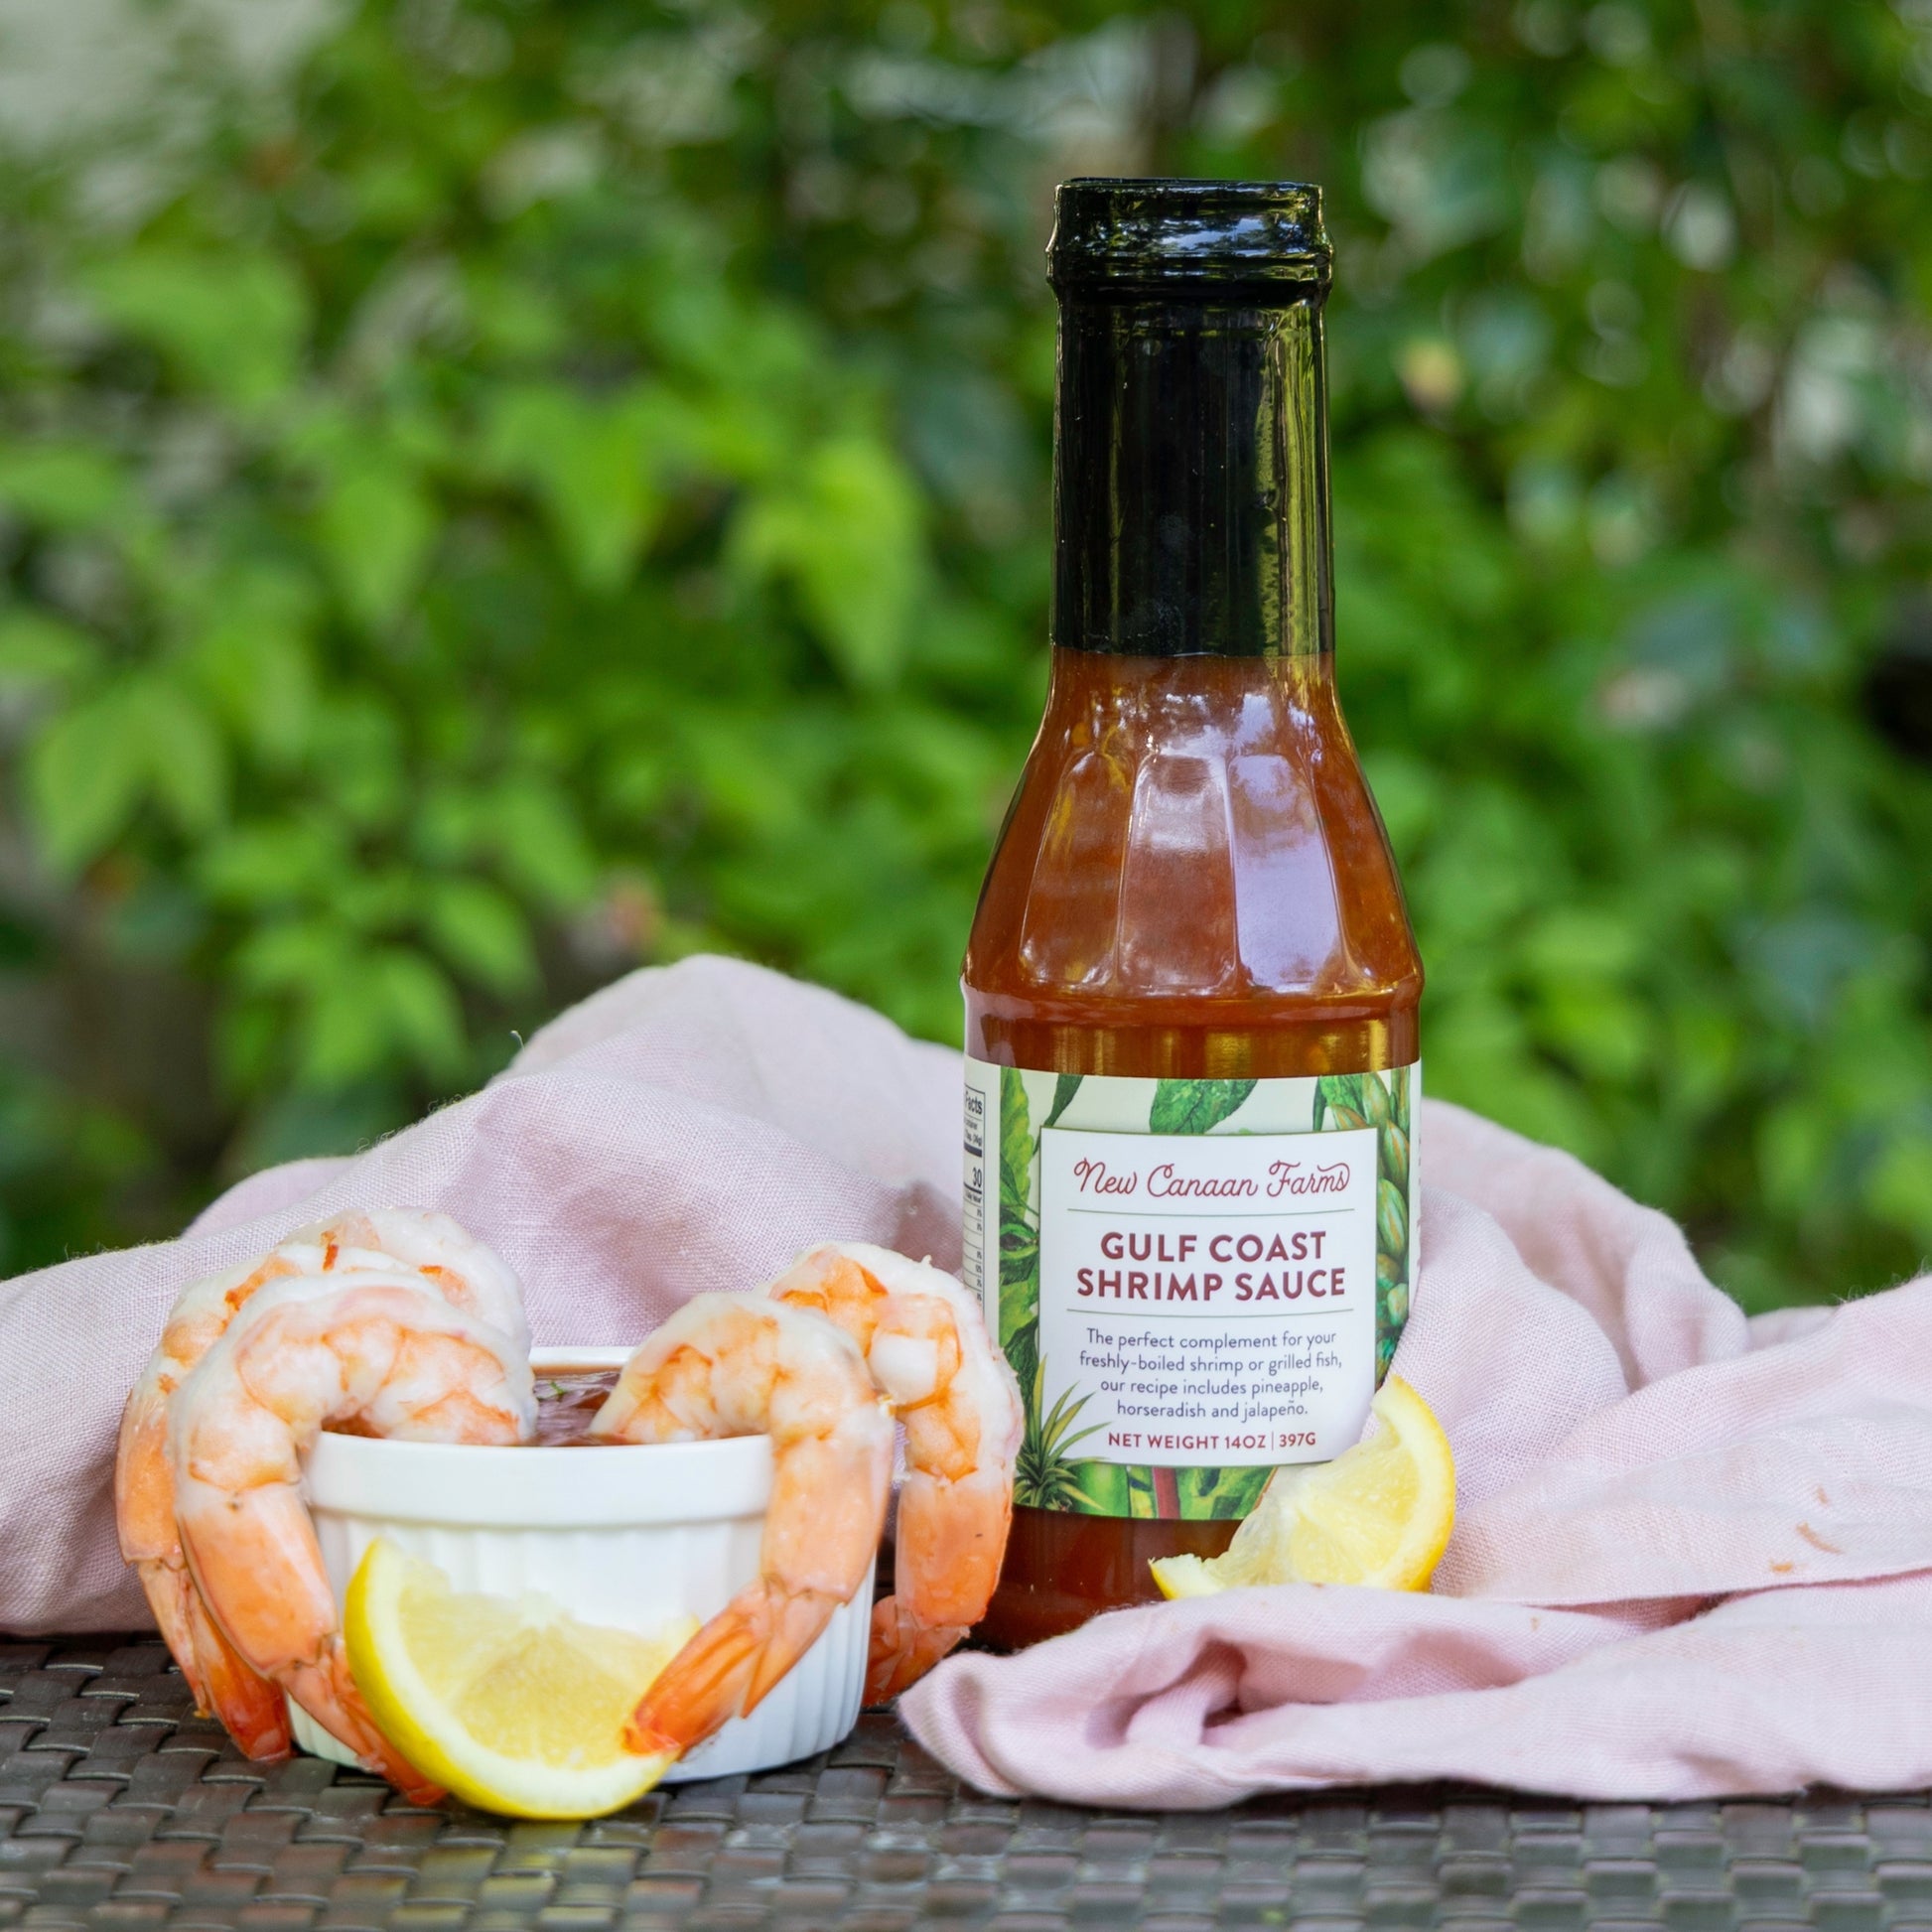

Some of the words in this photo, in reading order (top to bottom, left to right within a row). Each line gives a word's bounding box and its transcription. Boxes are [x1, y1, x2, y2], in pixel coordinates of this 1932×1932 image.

[1074, 1158, 1137, 1194] New
[1147, 1164, 1258, 1197] Canaan
[1267, 1160, 1350, 1197] Farms
[1101, 1232, 1197, 1262] GULF
[1209, 1231, 1325, 1263] COAST
[1077, 1268, 1222, 1301] SHRIMP
[1235, 1268, 1345, 1301] SAUCE
[1087, 1328, 1113, 1344] The
[1119, 1331, 1173, 1351] perfect
[1179, 1333, 1277, 1353] complement
[1283, 1331, 1302, 1345] for
[1308, 1333, 1335, 1350] your
[1080, 1350, 1184, 1374] freshly-boiled
[1190, 1356, 1243, 1376] shrimp
[1249, 1361, 1263, 1370] or
[1269, 1353, 1311, 1376] grilled
[1316, 1352, 1341, 1370] fish,
[1101, 1381, 1125, 1391] our
[1131, 1383, 1177, 1399] recipe
[1183, 1379, 1246, 1394] includes
[1252, 1376, 1322, 1399] pineapple,
[1118, 1400, 1205, 1417] horseradish
[1211, 1403, 1238, 1418] and
[1242, 1396, 1308, 1423] jalapeño.
[1109, 1433, 1142, 1448] NET
[1148, 1435, 1219, 1449] WEIGHT
[1225, 1435, 1266, 1449] 14OZ
[1280, 1433, 1315, 1448] 397G
